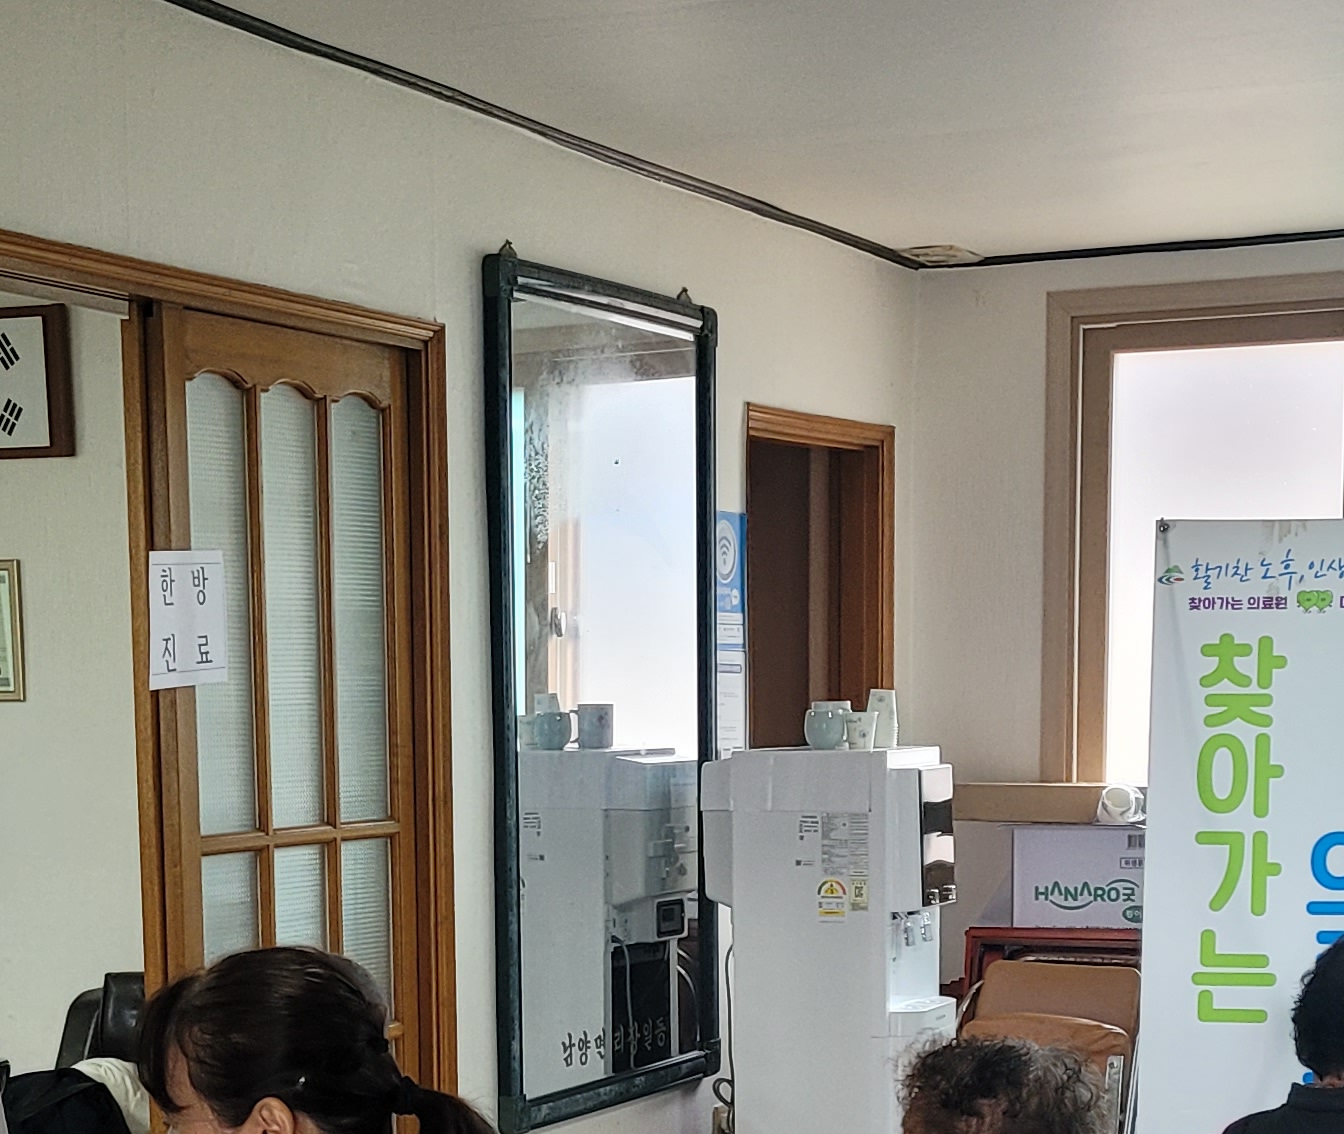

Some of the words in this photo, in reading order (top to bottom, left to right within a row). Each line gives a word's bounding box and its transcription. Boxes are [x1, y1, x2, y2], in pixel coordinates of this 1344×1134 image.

[1191, 557, 1254, 591] 활기찬
[1188, 596, 1244, 611] 찾아가는
[1247, 596, 1288, 611] 의료원
[1191, 632, 1288, 1025] 찾아가는
